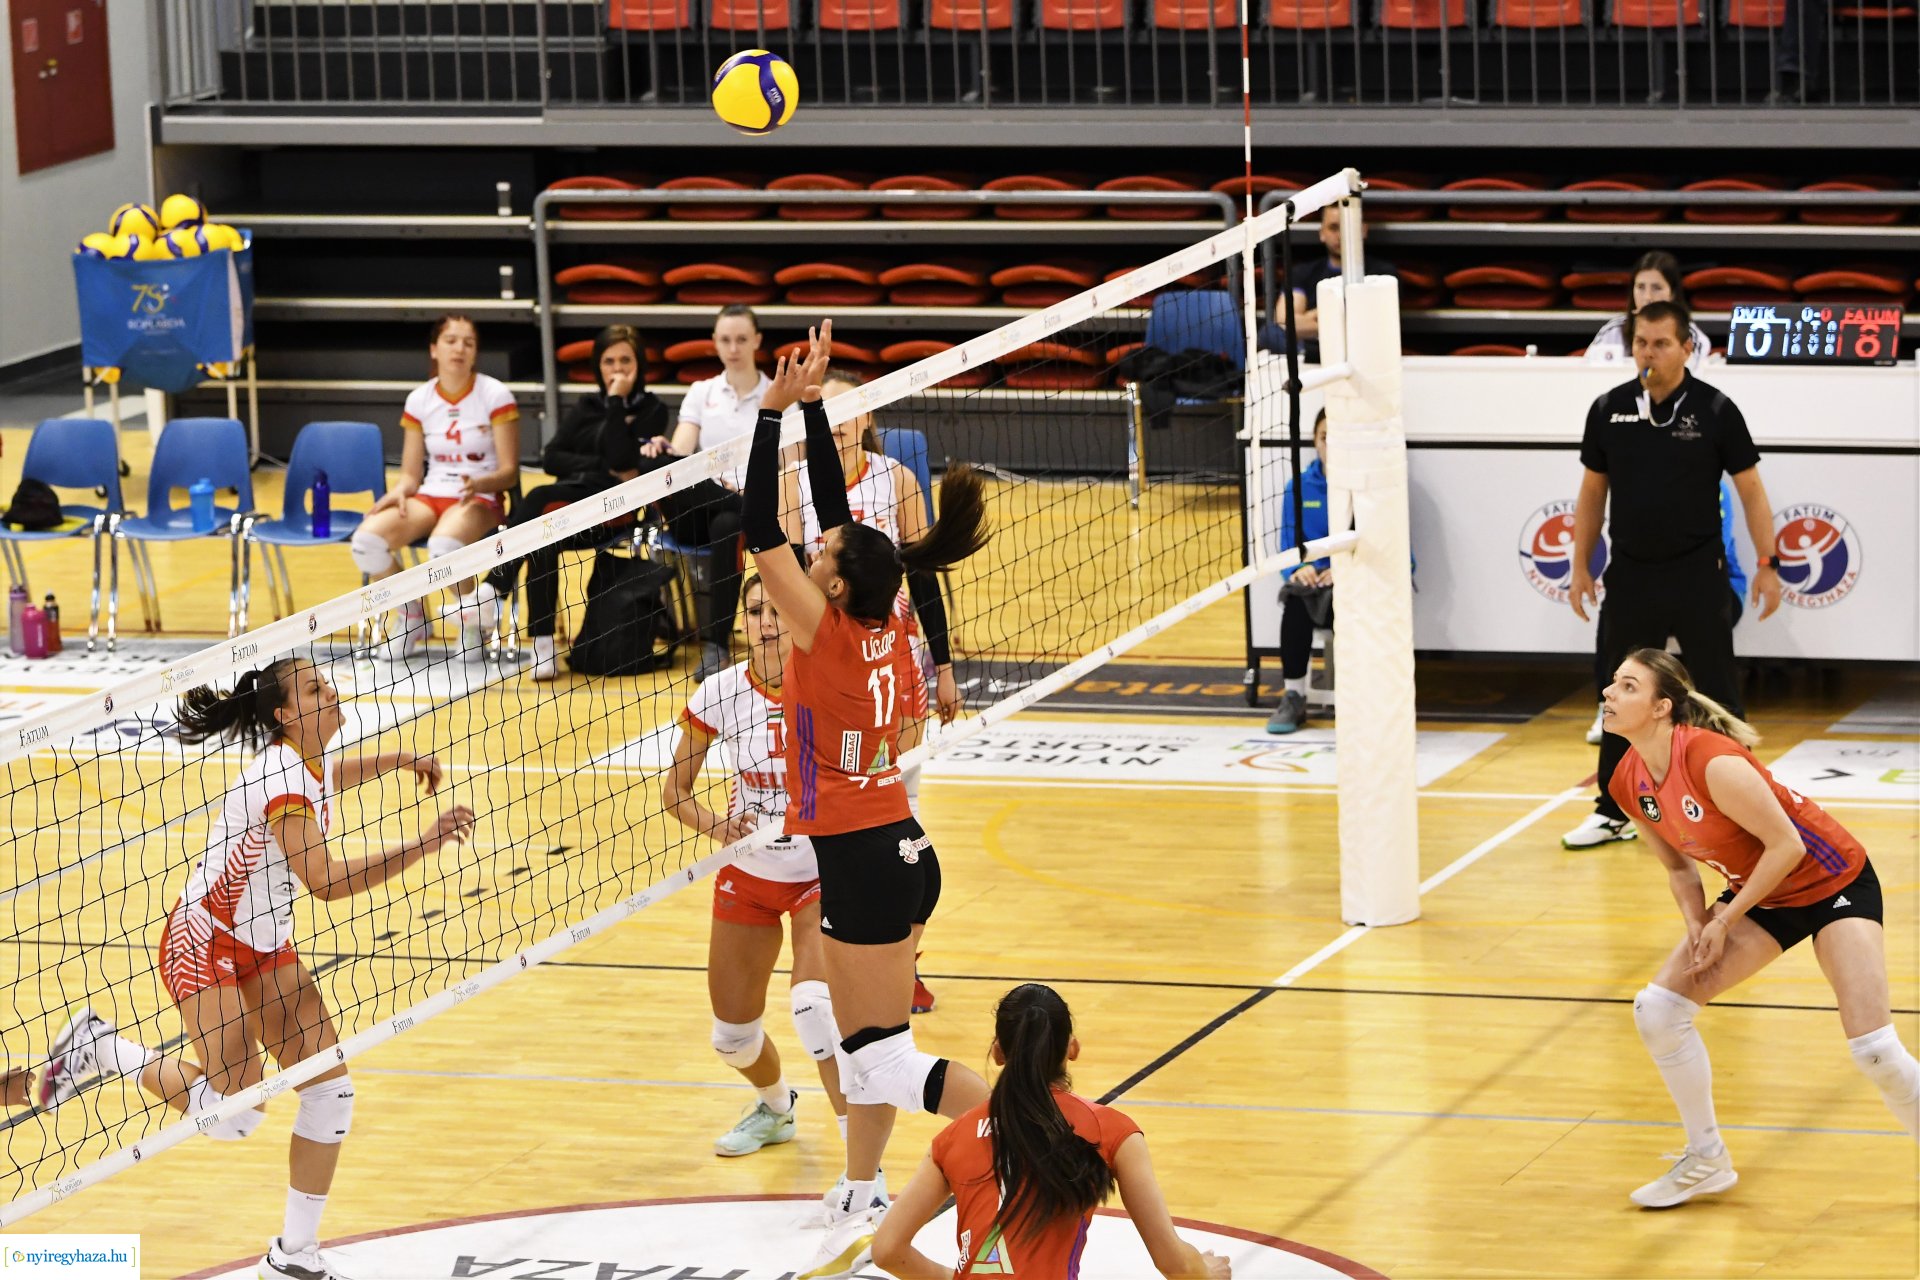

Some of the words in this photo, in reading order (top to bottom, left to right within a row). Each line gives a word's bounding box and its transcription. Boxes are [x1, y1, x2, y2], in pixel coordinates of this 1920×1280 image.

[445, 420, 462, 445] 4
[603, 495, 627, 513] FATUM
[1784, 506, 1835, 521] FATUM
[428, 565, 453, 584] FATUM
[231, 642, 259, 664] FATUM
[867, 663, 896, 728] 17
[18, 725, 50, 748] FATUM
[956, 738, 1190, 754] SPORTC
[932, 751, 1164, 766] NYÍREG
[571, 926, 592, 943] FATUM
[391, 1016, 415, 1034] FATUM
[195, 1114, 220, 1131] FATUM
